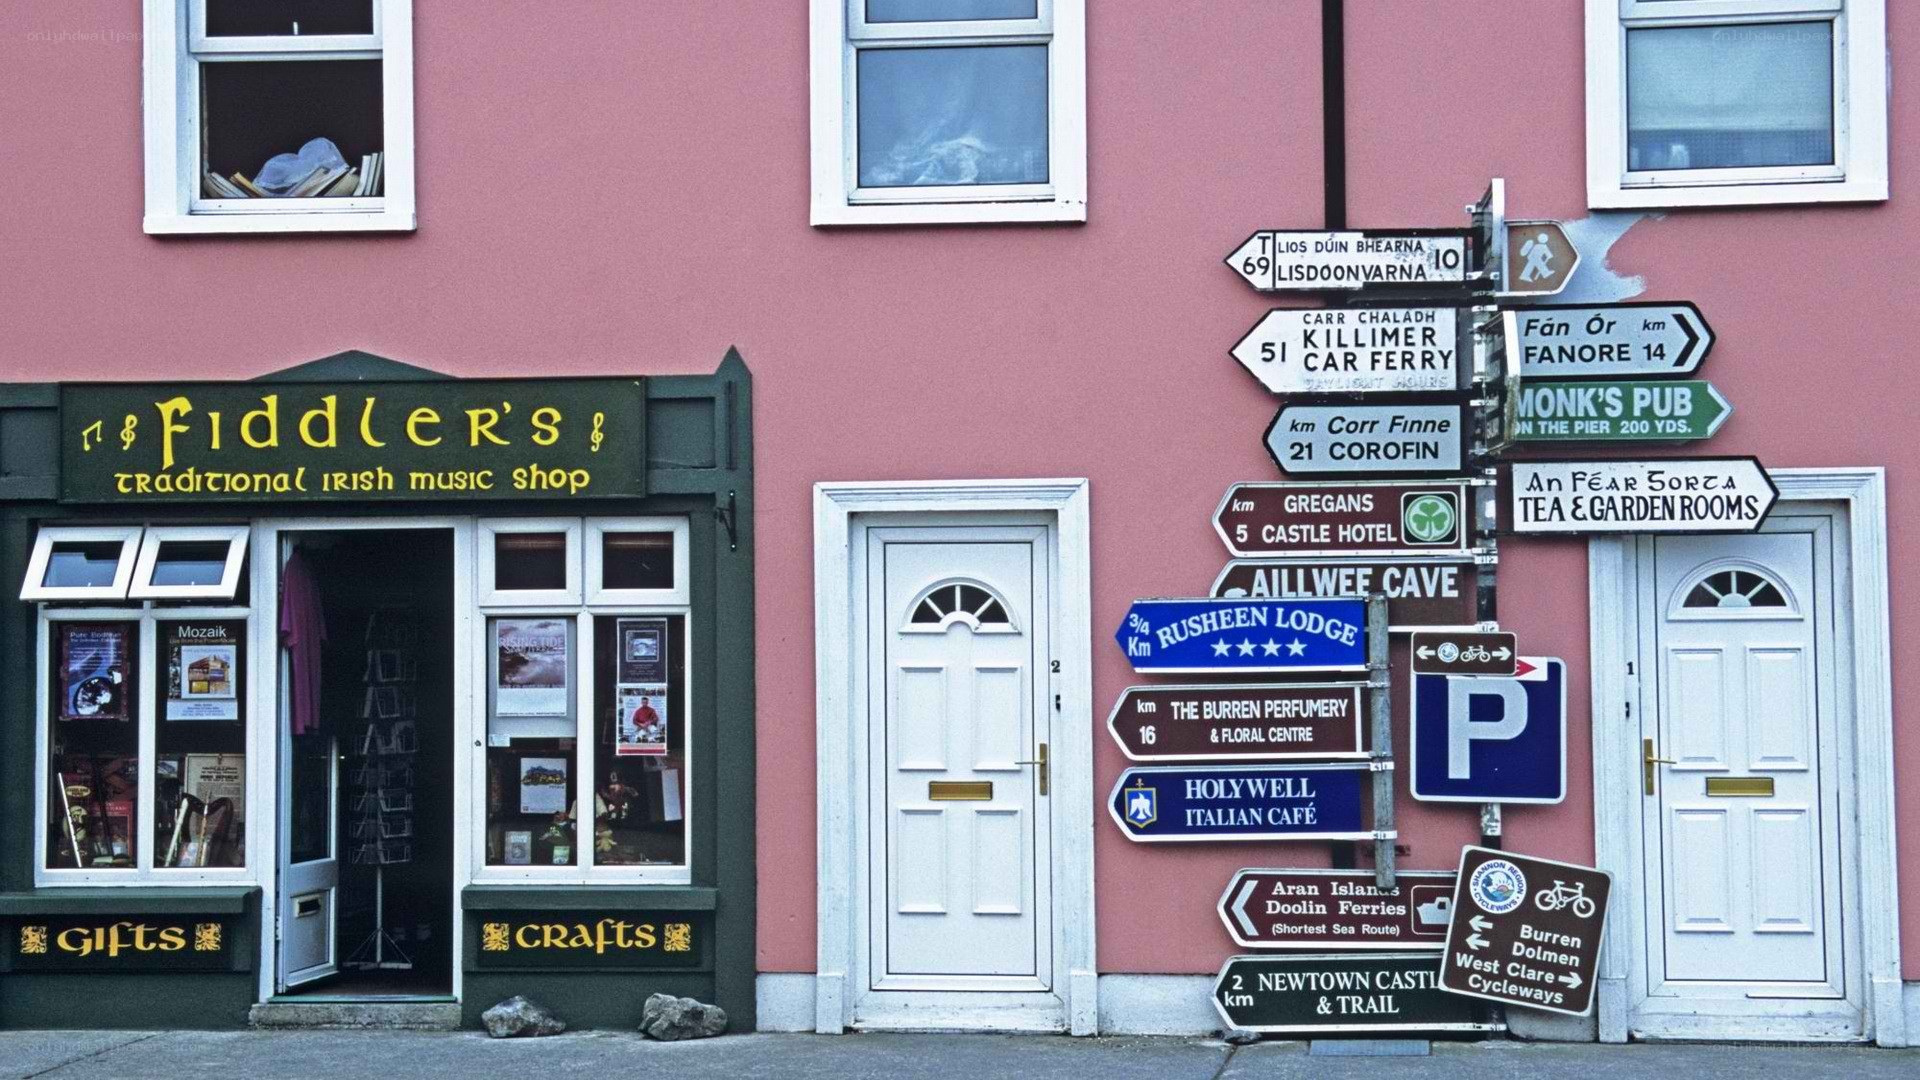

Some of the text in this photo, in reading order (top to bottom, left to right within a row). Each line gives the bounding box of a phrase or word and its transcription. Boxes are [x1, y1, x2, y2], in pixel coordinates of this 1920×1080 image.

[1257, 236, 1270, 255] T
[1278, 237, 1423, 253] LIOS DÚIN BHEARNA
[1243, 257, 1270, 275] 69
[1435, 249, 1459, 270] 10
[1278, 264, 1426, 281] LISDOONVARNA
[1303, 311, 1435, 324] CARR CHALADH
[1524, 313, 1665, 336] Fán Ór km
[1303, 327, 1436, 348] KILLIMER
[1261, 342, 1286, 362] 51
[1304, 350, 1453, 371] CAR FERRY
[1525, 344, 1665, 363] FANORE 14
[1518, 387, 1692, 418] MONK'S PUB
[1290, 419, 1315, 432] km
[1327, 416, 1378, 434] Corr
[1538, 421, 1569, 434] THE
[1574, 420, 1610, 434] PIER
[1620, 420, 1648, 433] 200
[1655, 420, 1691, 433] YDS.
[1290, 441, 1439, 460] 21 COROFIN
[1526, 472, 1562, 491] An
[1232, 494, 1374, 513] km GREGANS
[1518, 496, 1565, 522] TEA
[1680, 495, 1759, 521] ROOMS
[1236, 524, 1397, 543] 5 CASTLE HOTEL
[1251, 567, 1459, 598] AILLWEE CAVE
[178, 625, 227, 638] Mozaik
[1129, 607, 1358, 649] 3/4 RUSHEEN LODGE
[1128, 637, 1151, 657] Km
[1051, 660, 1060, 673] 2
[1627, 661, 1634, 675] 1
[1137, 699, 1348, 720] km THE BURREN PERFUMERY
[1139, 725, 1313, 745] 16 & FLORAL CENTRE
[1448, 679, 1528, 779] P
[1185, 778, 1316, 800] HOLYWELL
[1185, 802, 1317, 827] ITALIAN CAFÉ
[1271, 881, 1400, 896] Aran Islans
[1472, 862, 1524, 895] SHANNON REGION
[1265, 900, 1406, 915] Doolin Ferries
[1474, 892, 1518, 911] CYCLEWAYS
[1272, 923, 1400, 936] (Shortest Sea Route)
[1520, 924, 1582, 949] Burren
[1512, 941, 1580, 968] Dolmen
[1455, 952, 1555, 984] West Clare
[1232, 970, 1440, 992] 2 NEWTOWN CASTL
[1468, 974, 1564, 1004] Cycleways
[1224, 991, 1400, 1015] km & TRAIL
